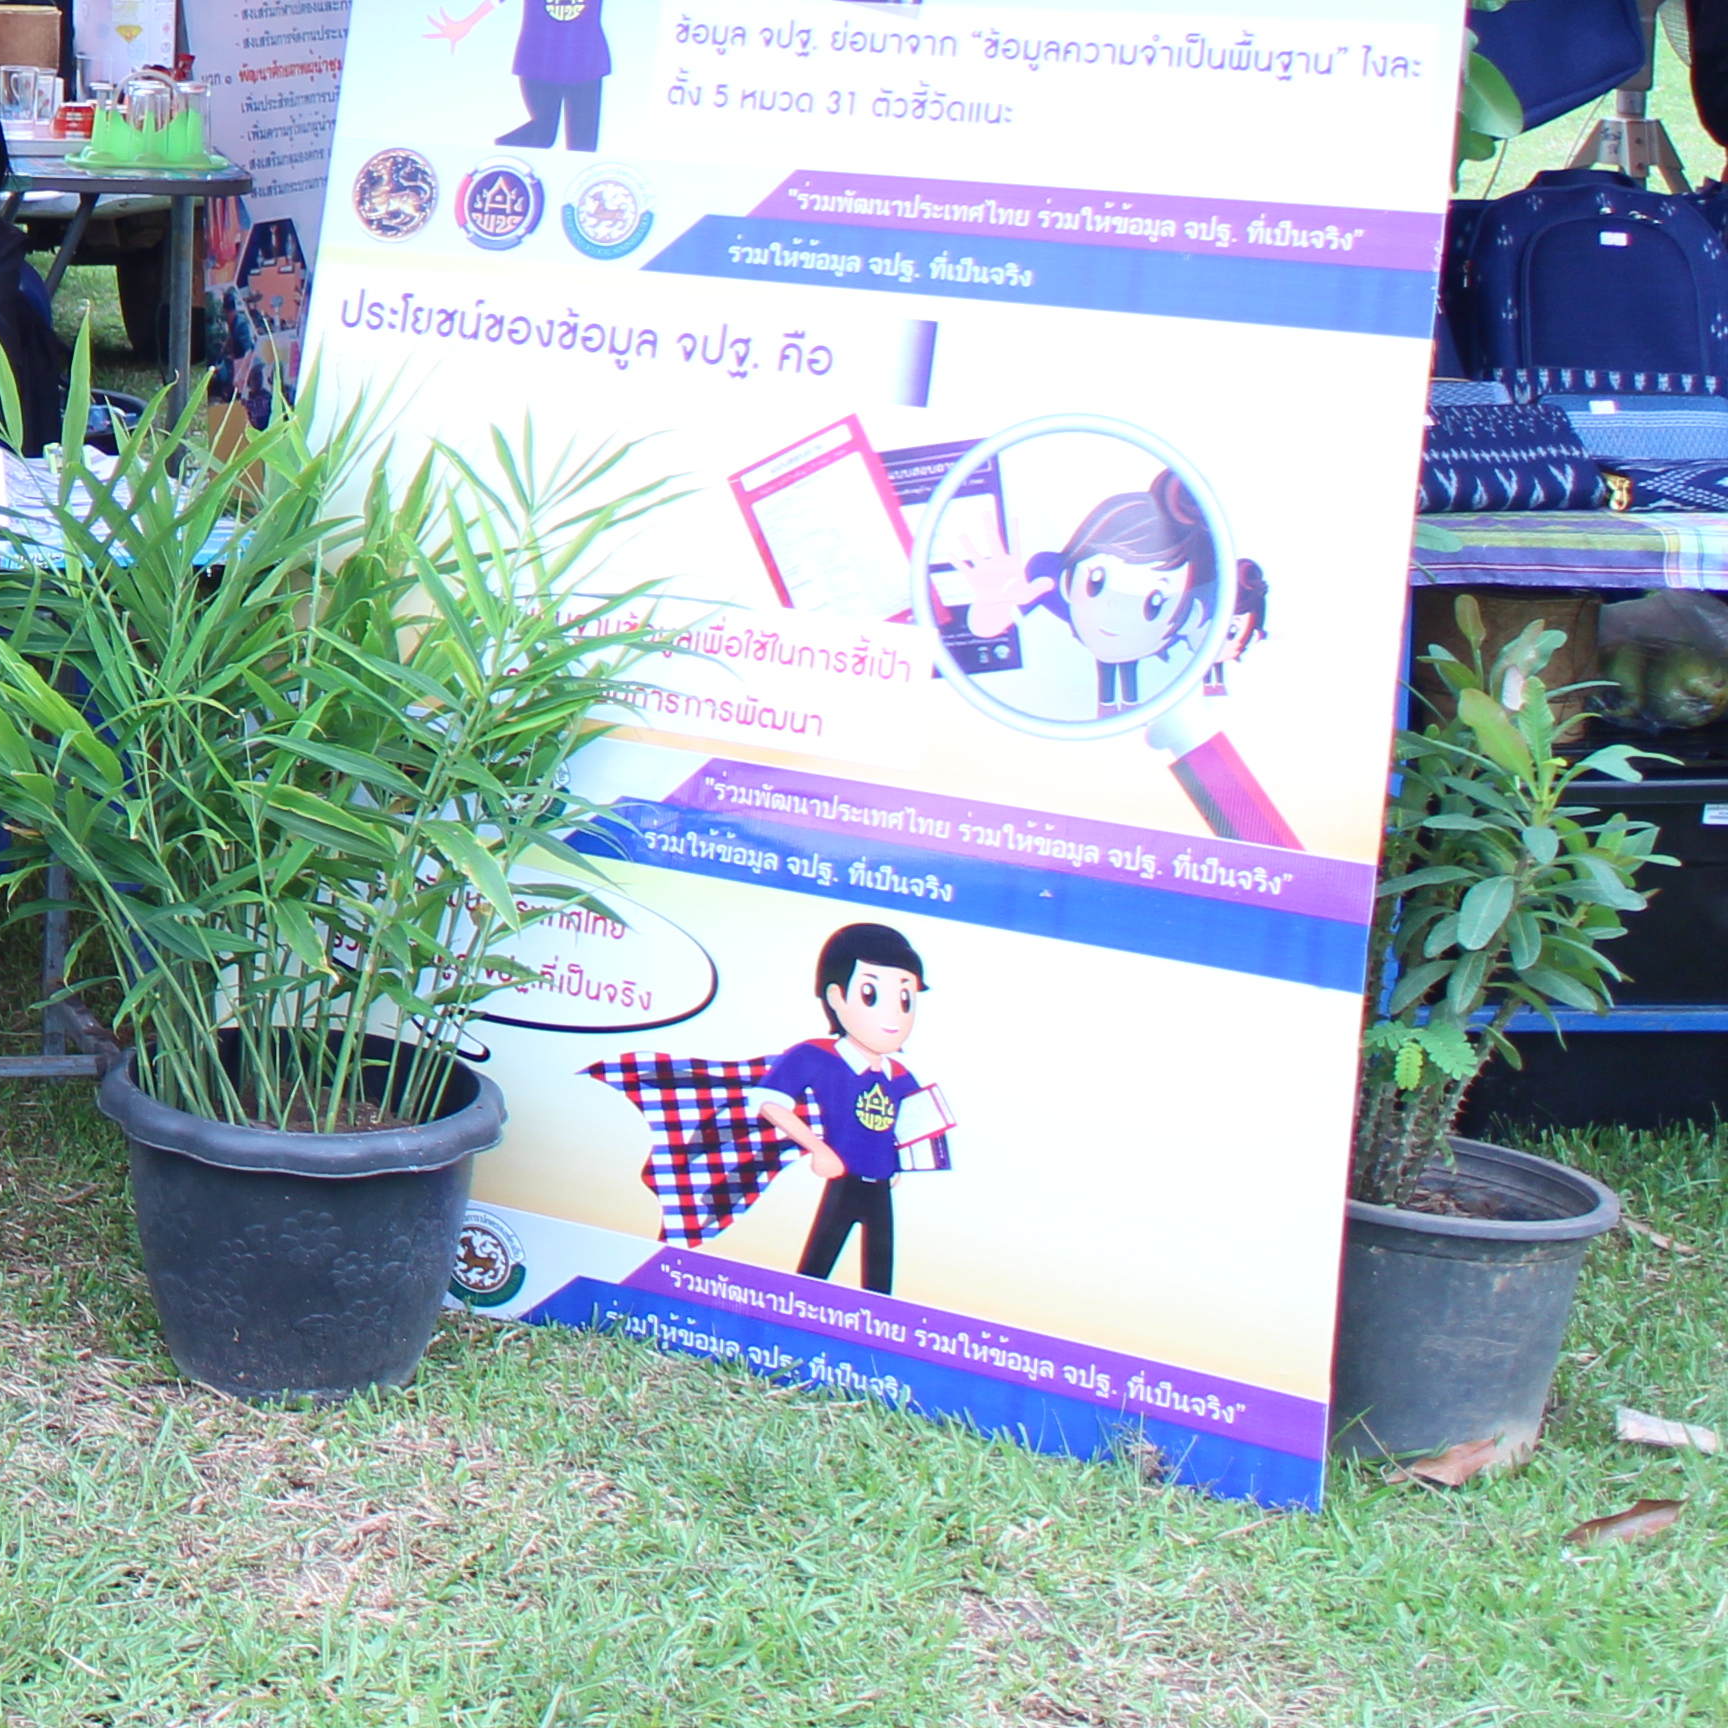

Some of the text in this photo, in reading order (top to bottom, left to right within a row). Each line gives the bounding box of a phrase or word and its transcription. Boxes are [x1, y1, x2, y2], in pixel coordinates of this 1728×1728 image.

[675, 14, 747, 56] ข้อมูล
[758, 20, 818, 57] จปฐ.
[830, 21, 958, 58] ย่อมาจาก
[1361, 44, 1422, 79] ไงละ
[667, 66, 1014, 126] ตั้ง 5 หมวด 31 ตัวชี้วัดแนะ
[1037, 198, 1177, 243] ร่วมให้ข้อมูล
[1184, 215, 1239, 248] จปฐ.
[727, 233, 1034, 288] ร่วมให้ข้อมูล จปฐ. ที่เป็นจริง
[340, 288, 834, 379] ประโยชน์ของข้อมูล จปฐ. คือ
[644, 819, 955, 902] ร่วมให้ข้อมูล จปฐ. ที่เป็นจริง
[958, 811, 1101, 868] ร่วมให้ข้อมูล
[1108, 845, 1163, 880] จปฐ.
[914, 1317, 1055, 1381] ร่วมให้ข้อมูล
[1062, 1364, 1118, 1399] จปฐ.
